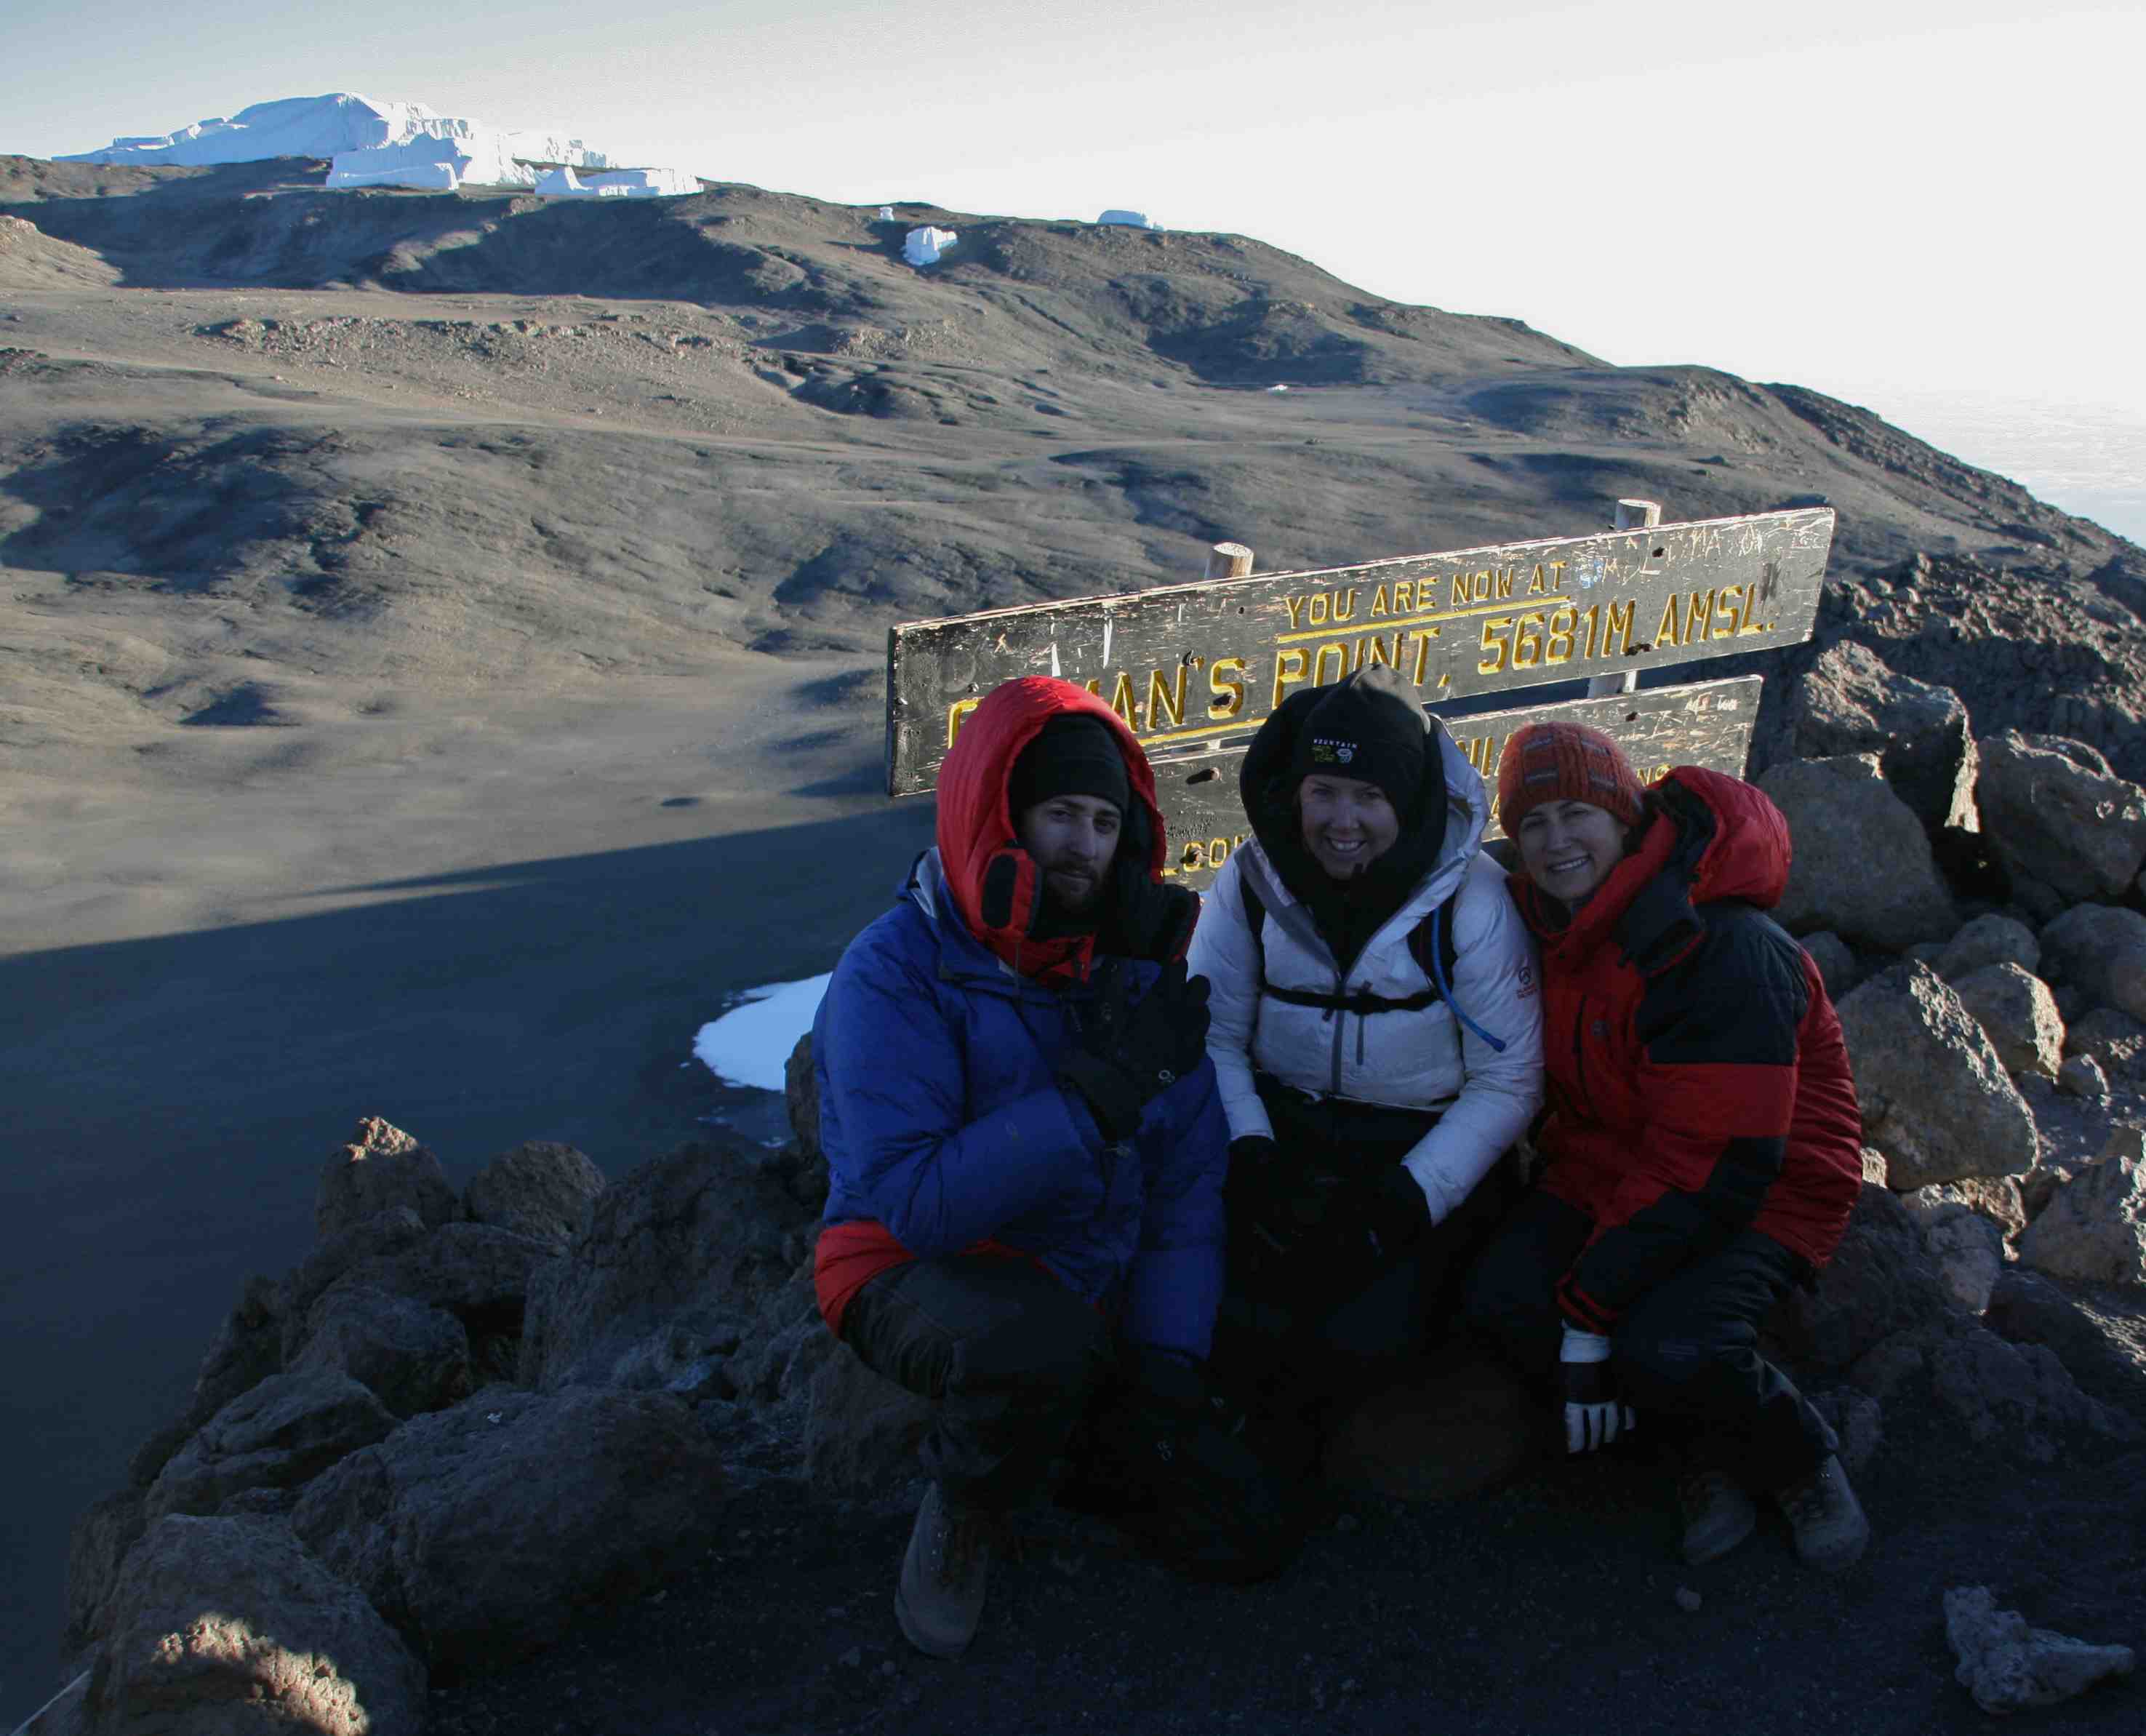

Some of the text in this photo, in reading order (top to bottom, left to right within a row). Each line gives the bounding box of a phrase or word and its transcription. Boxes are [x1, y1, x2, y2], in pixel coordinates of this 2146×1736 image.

[1285, 560, 1566, 628] YOU ARE NOW AT
[1477, 598, 1636, 675] 5681M
[1653, 583, 1775, 650] AMSL.
